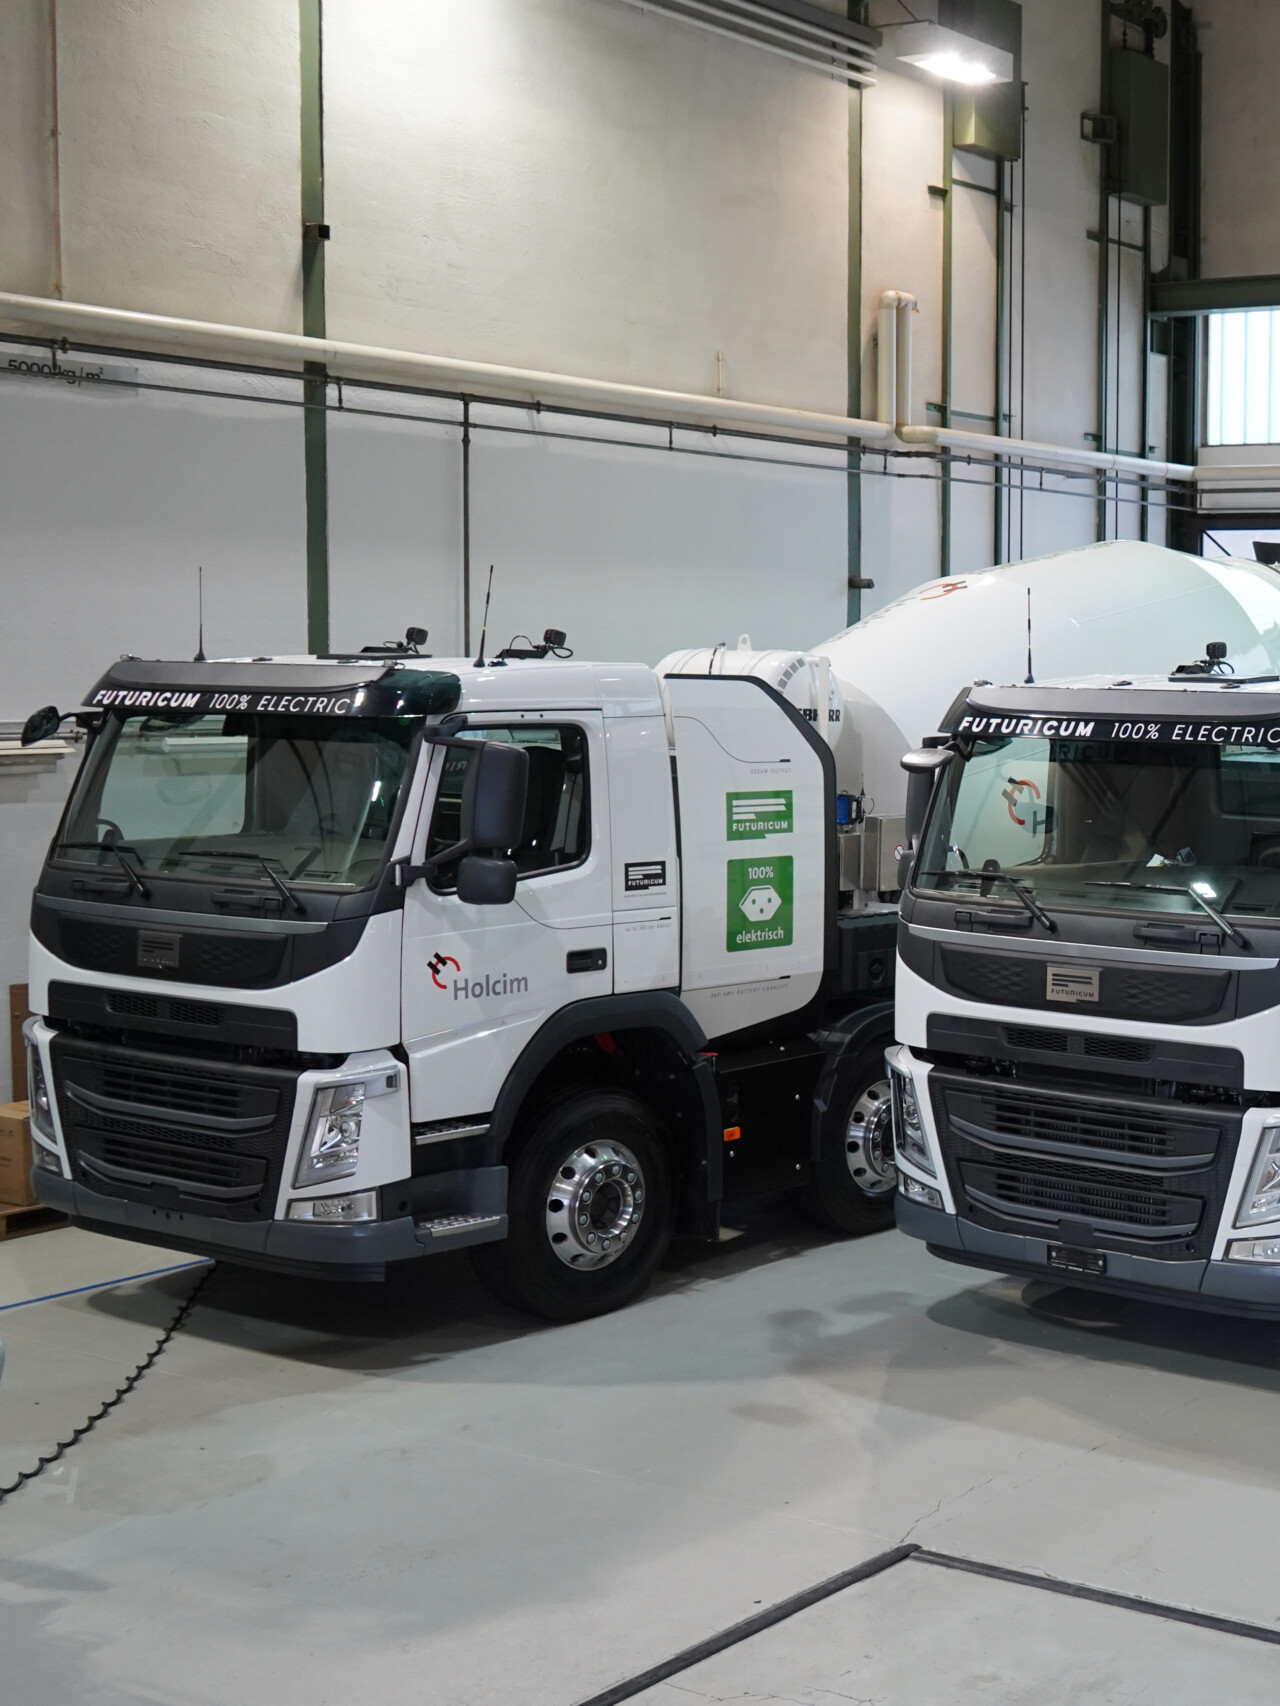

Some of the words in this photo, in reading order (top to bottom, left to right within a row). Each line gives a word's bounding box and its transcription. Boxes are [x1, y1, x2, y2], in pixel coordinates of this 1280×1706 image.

[93, 690, 201, 708] FUTURICUM
[208, 693, 252, 710] 100%
[256, 695, 352, 714] ELECTRIC
[958, 716, 1096, 737] FUTURICUM
[1111, 722, 1160, 740] 100%
[732, 820, 788, 832] FUTURICUM
[748, 866, 774, 879] 100%
[628, 878, 663, 887] FUTURICUM
[736, 926, 784, 944] elektrisch
[453, 973, 529, 1001] Holcim
[1051, 988, 1094, 998] FUTURICUM
